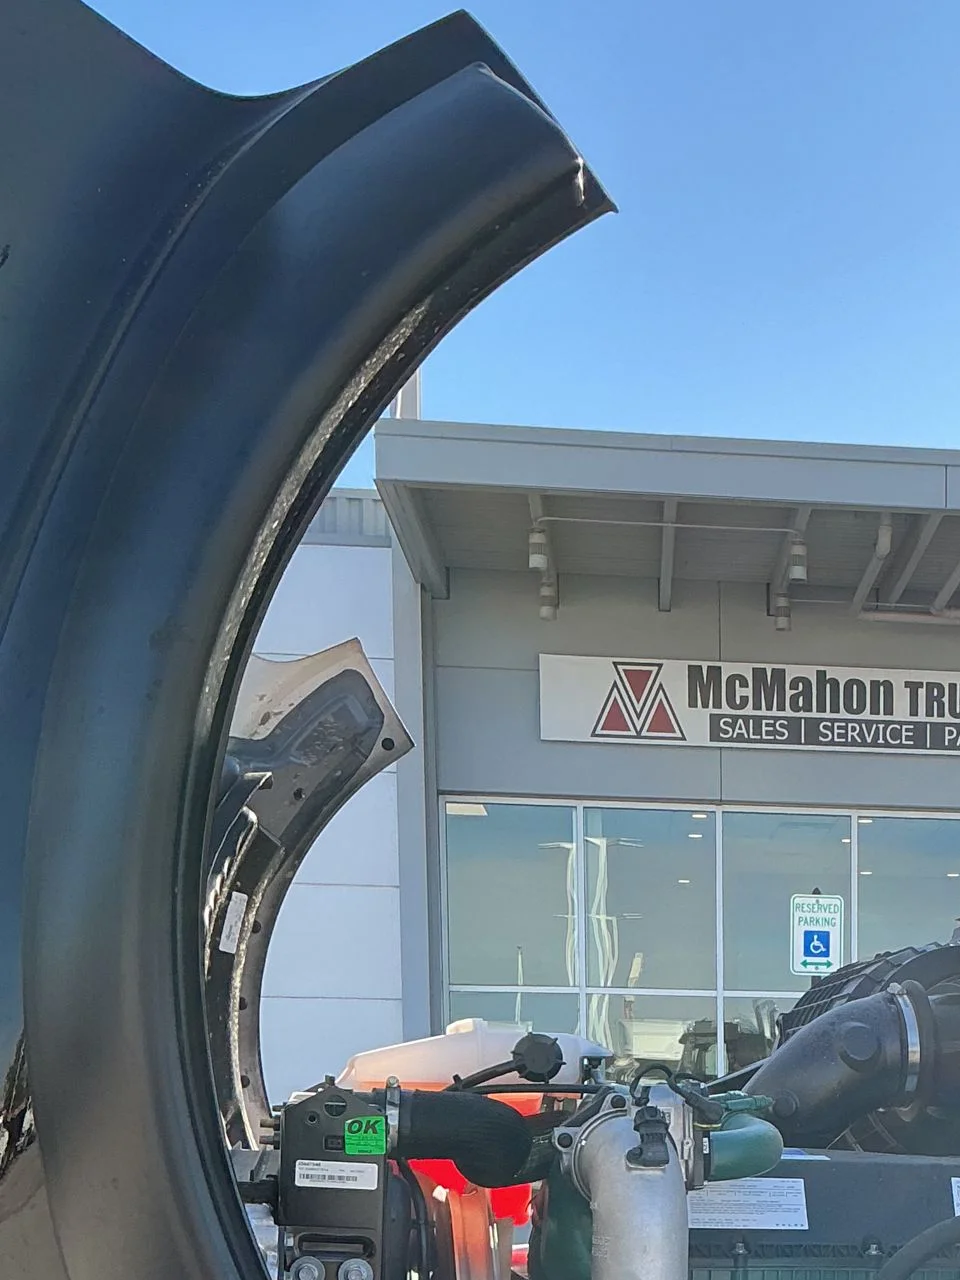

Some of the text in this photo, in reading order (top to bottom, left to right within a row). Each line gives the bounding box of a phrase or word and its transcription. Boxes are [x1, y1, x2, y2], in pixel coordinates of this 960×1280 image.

[687, 664, 894, 716] McMahon
[719, 717, 789, 741] SALES
[819, 721, 914, 746] SERVICE
[795, 903, 839, 914] RESERVED
[798, 916, 837, 927] PARKING
[347, 1119, 381, 1135] OK
